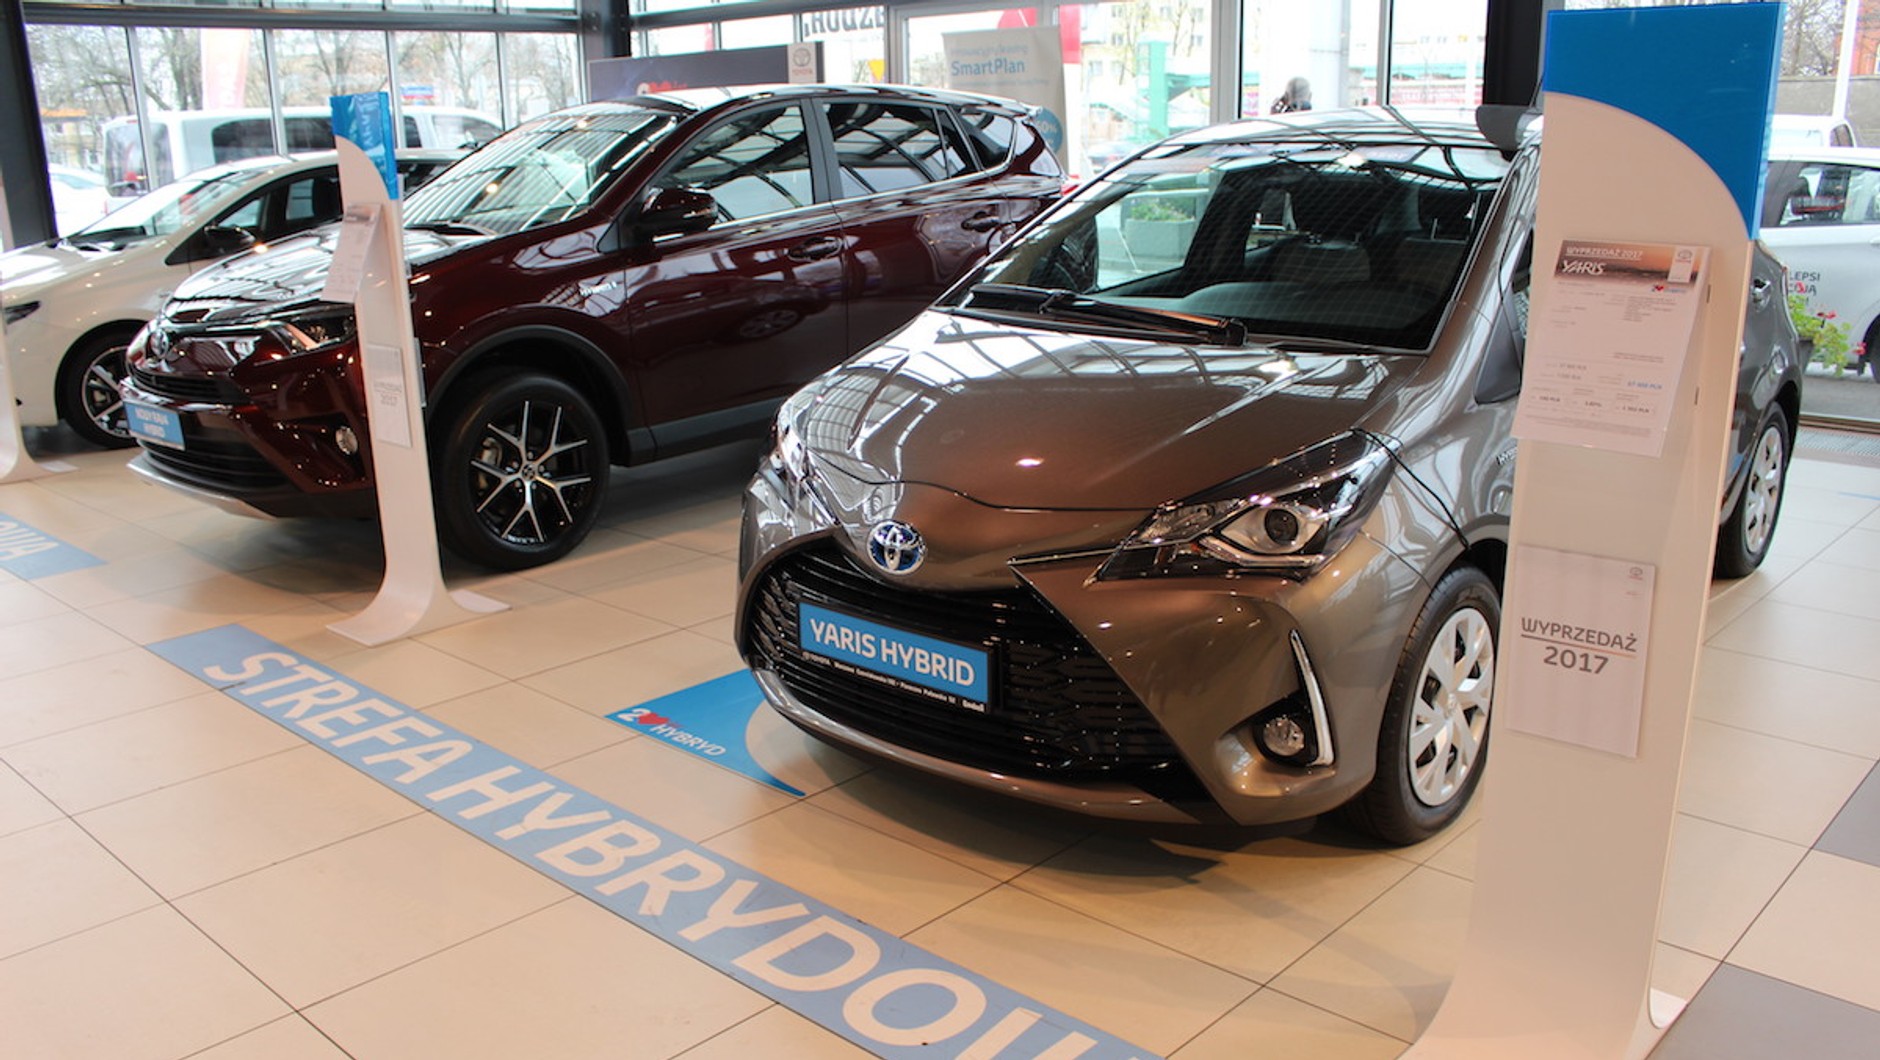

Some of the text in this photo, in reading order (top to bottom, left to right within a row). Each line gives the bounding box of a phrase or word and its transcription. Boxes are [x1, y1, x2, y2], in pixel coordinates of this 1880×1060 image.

[951, 57, 1025, 76] SmartPlan
[1561, 259, 1606, 276] YARIS
[809, 617, 975, 687] YARIS HYBRID
[1520, 617, 1638, 653] WYPRZEDAŻ
[1543, 646, 1609, 675] 2017
[203, 652, 473, 785] STREFA
[618, 708, 727, 756] 2 HYBRYD
